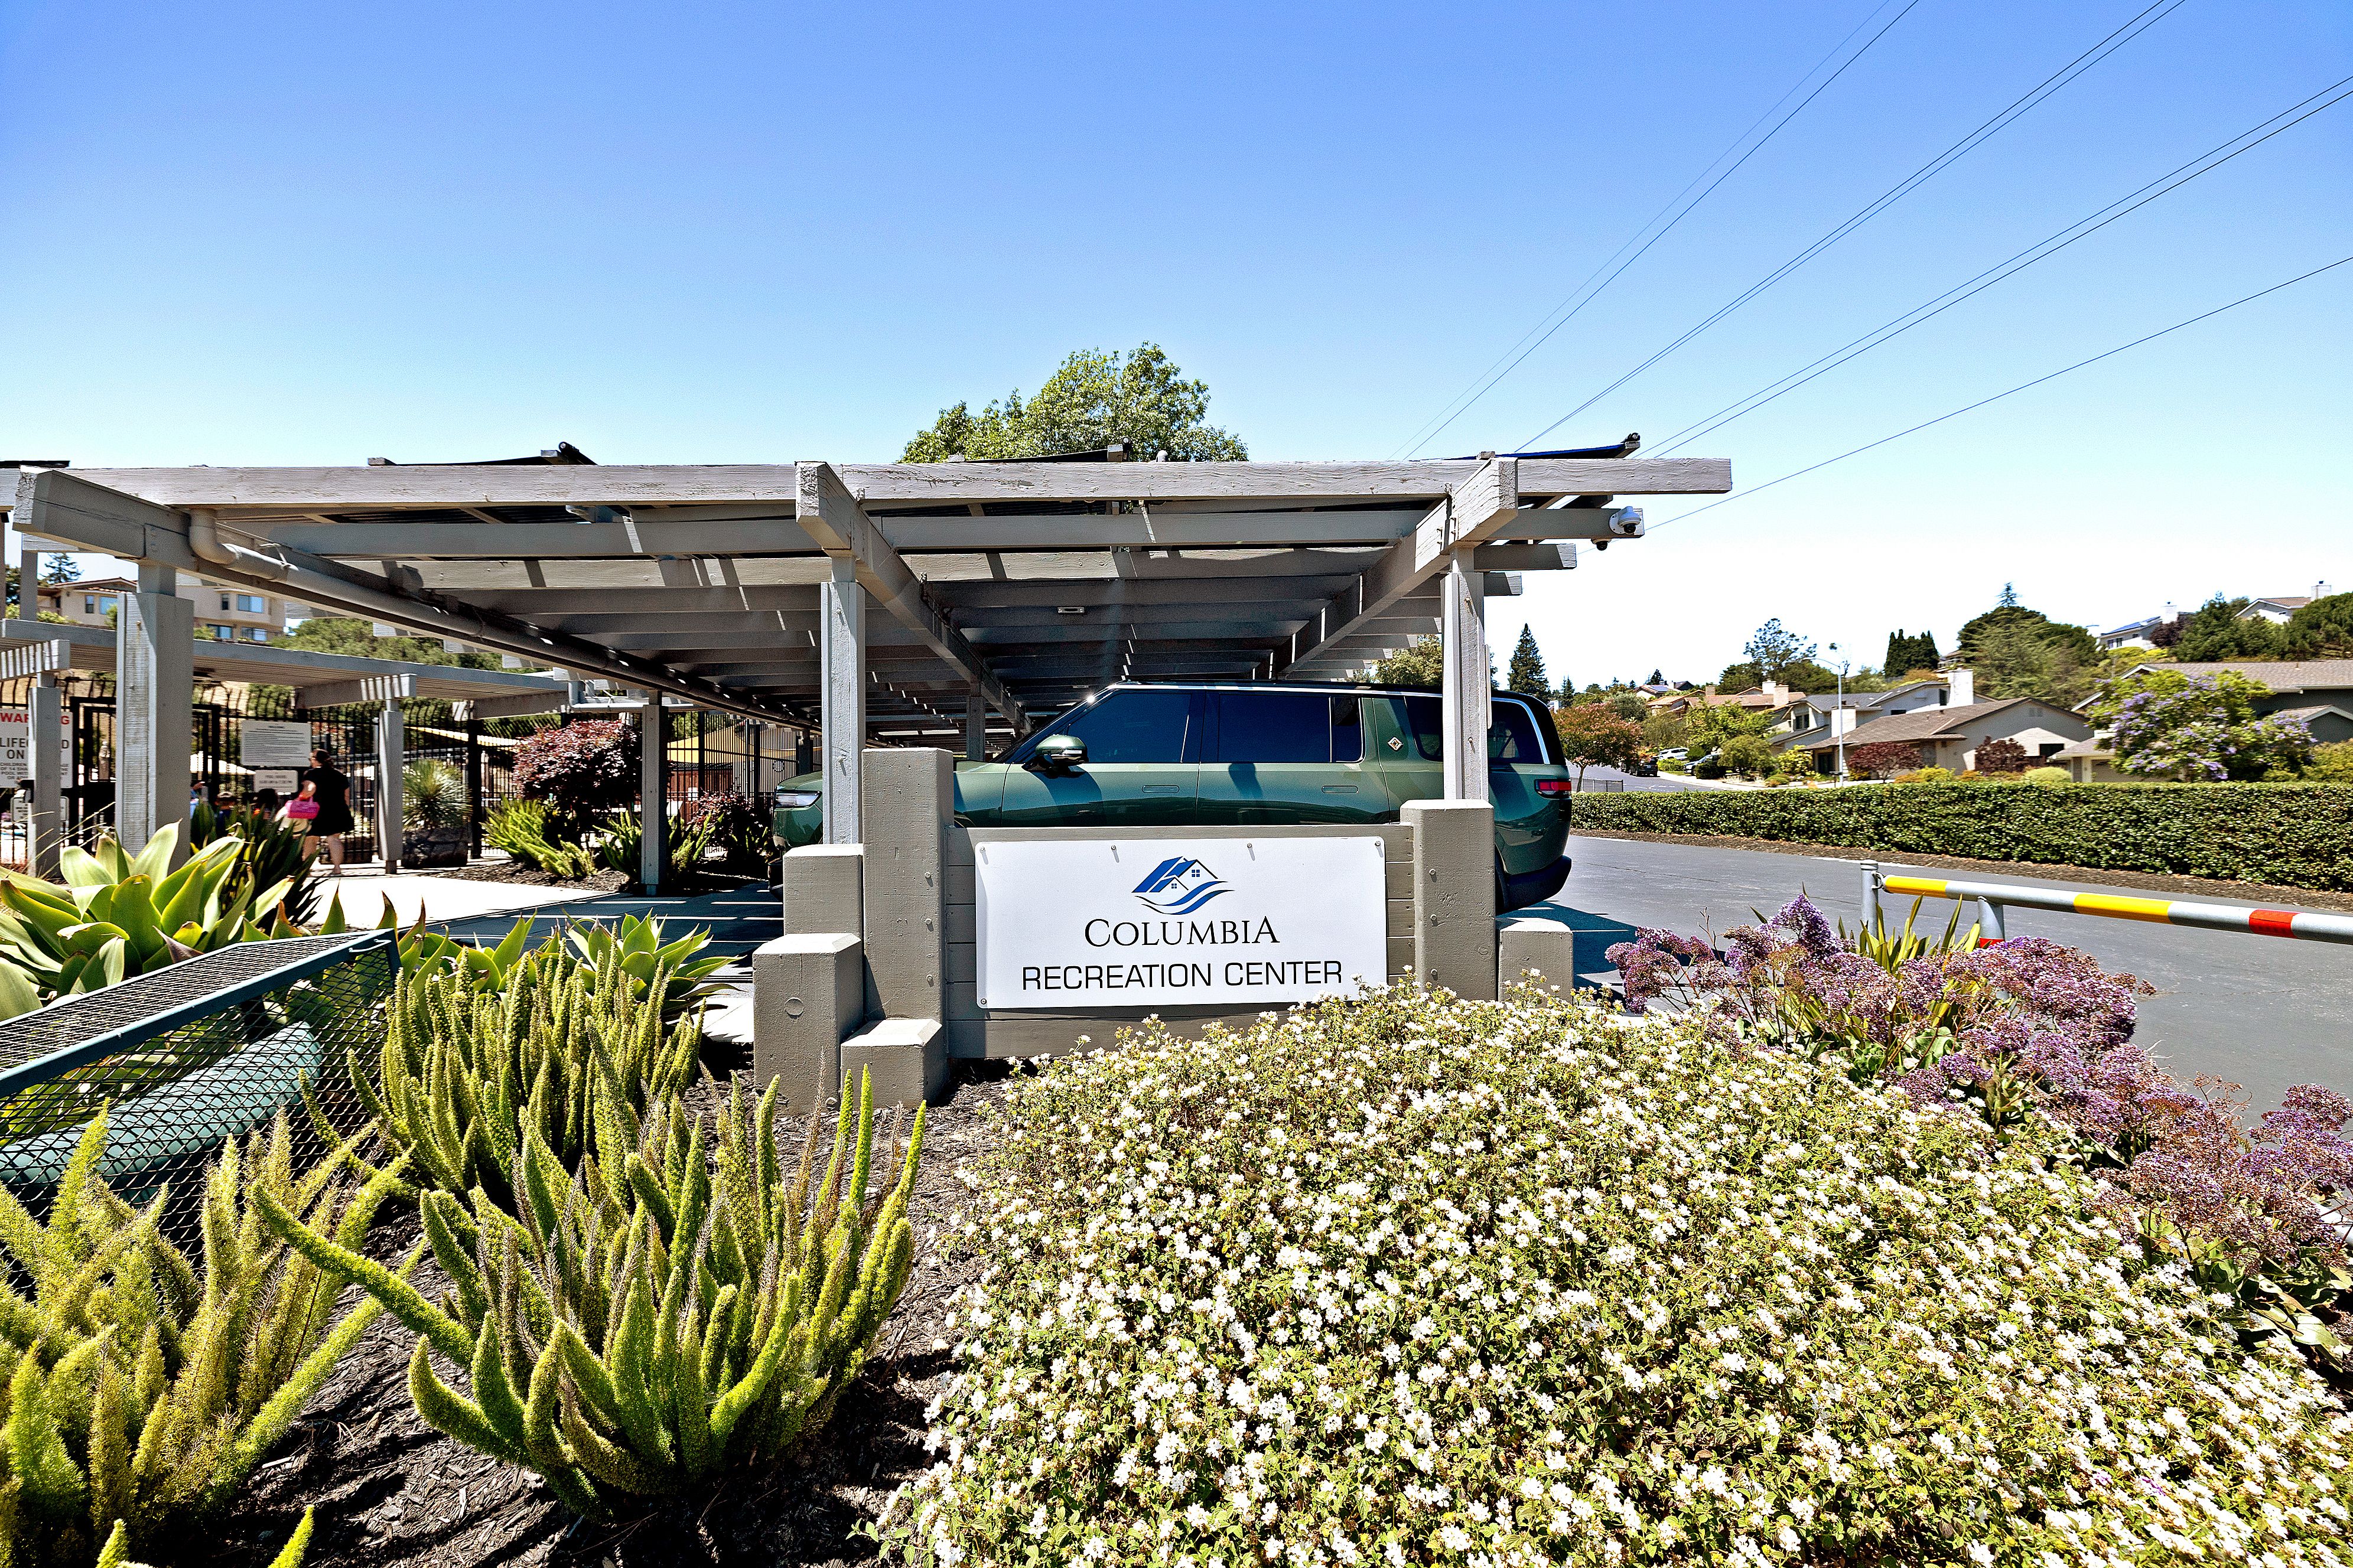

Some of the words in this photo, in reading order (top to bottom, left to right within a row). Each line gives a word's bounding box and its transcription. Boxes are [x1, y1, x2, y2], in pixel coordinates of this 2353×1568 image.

[6, 749, 24, 759] ON
[1085, 916, 1280, 947] COLUMBIA
[1023, 963, 1211, 990] RECREATION
[1225, 960, 1342, 986] CENTER
